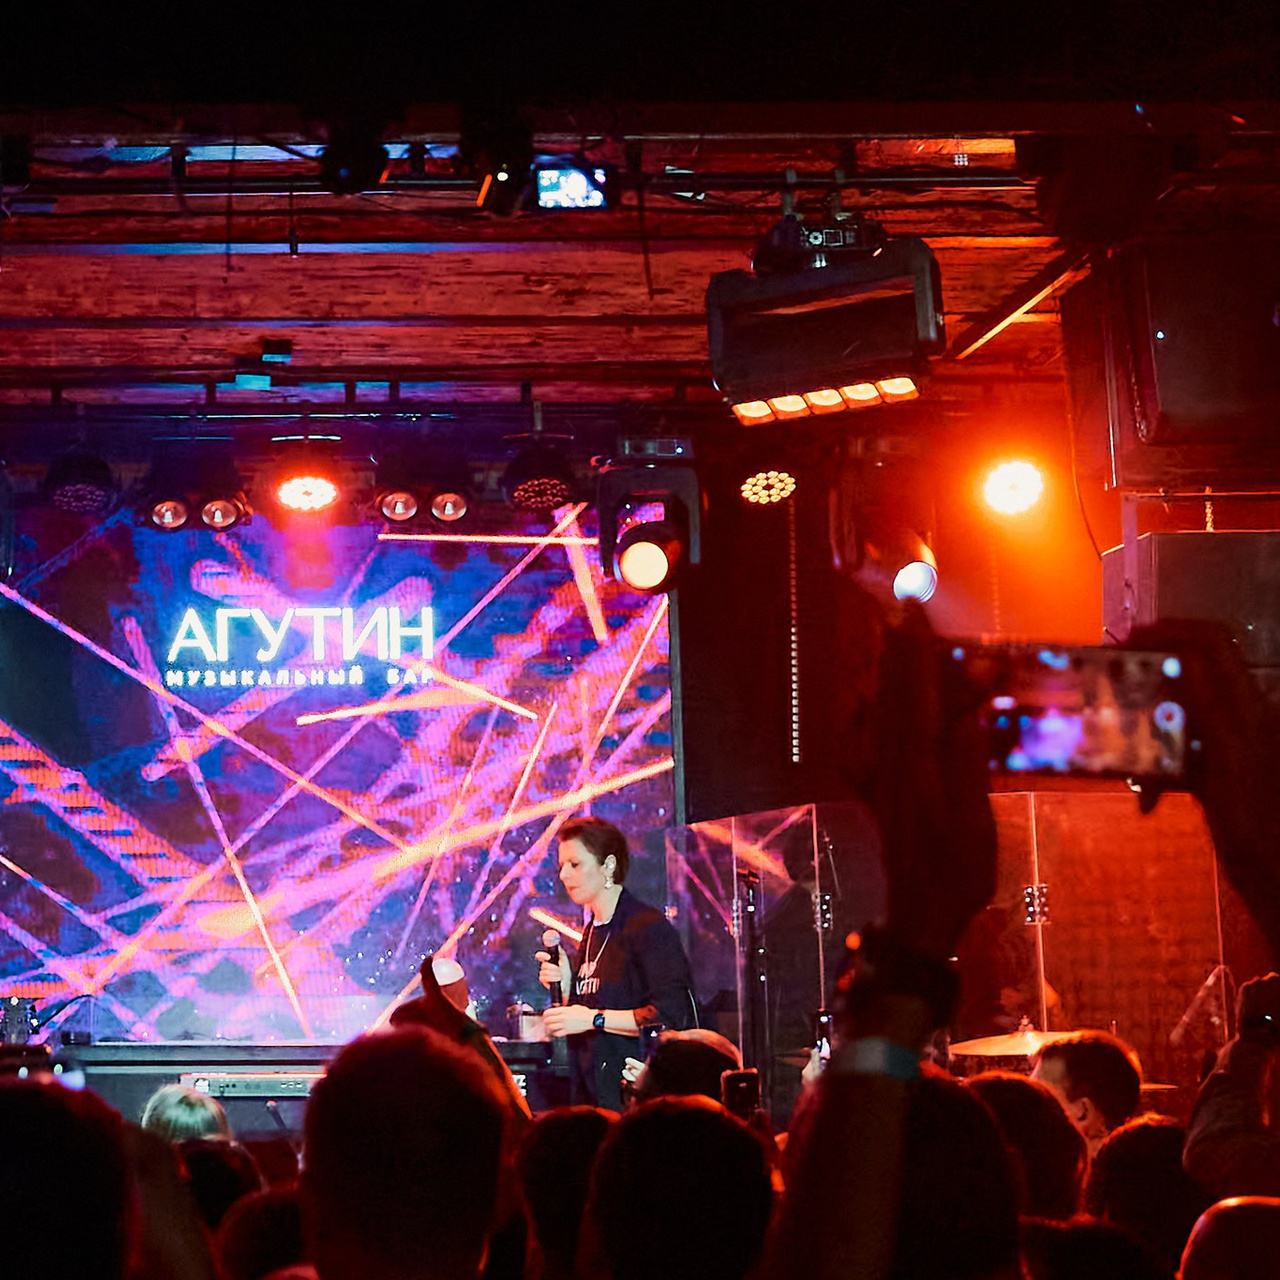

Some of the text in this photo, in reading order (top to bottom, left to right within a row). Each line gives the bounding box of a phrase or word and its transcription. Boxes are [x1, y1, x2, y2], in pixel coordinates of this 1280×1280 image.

[167, 607, 434, 662] АГУТИН
[166, 665, 434, 686] МУЗЫКАЛЬНЫЙ БАР
